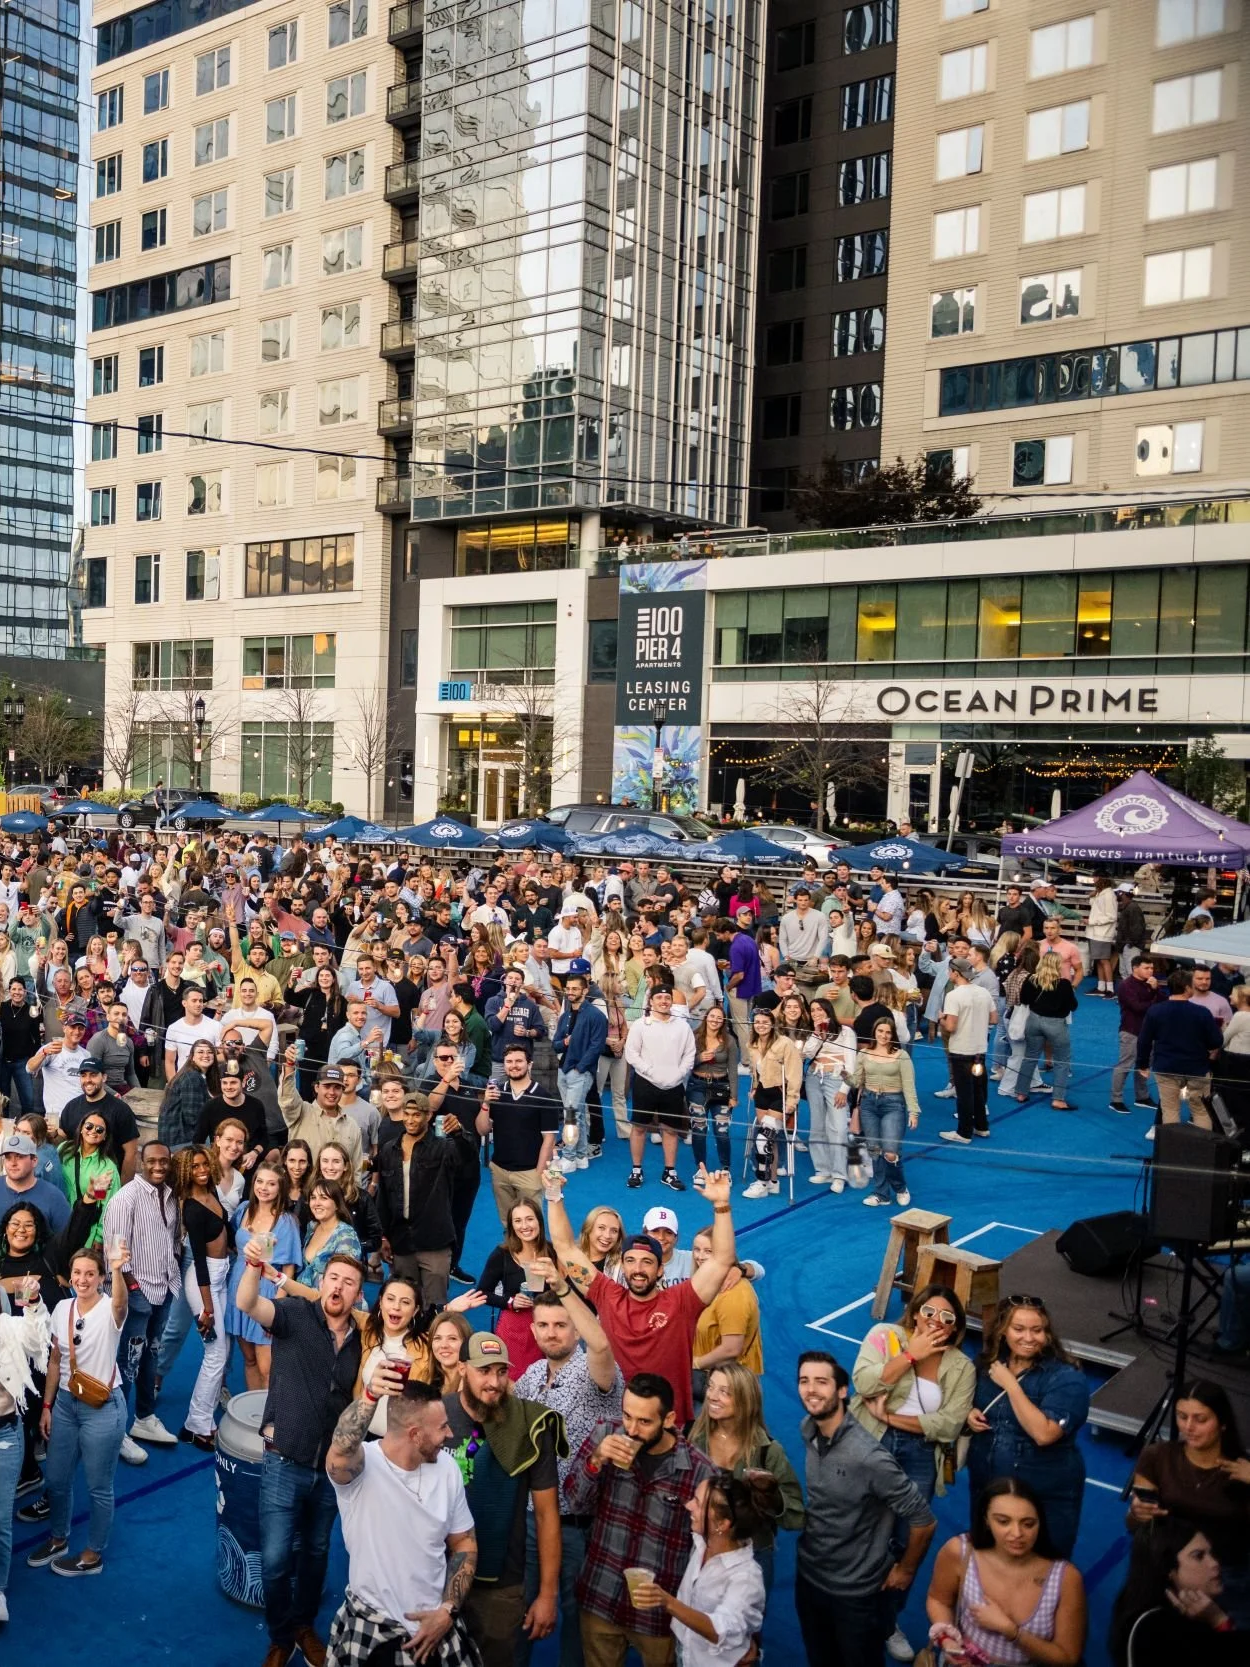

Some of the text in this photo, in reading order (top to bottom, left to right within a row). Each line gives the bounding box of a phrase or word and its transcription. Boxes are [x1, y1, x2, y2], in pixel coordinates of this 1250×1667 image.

[635, 636, 682, 661] PIER 4
[635, 661, 682, 669] APARTMENTS
[626, 680, 691, 694] LEASING
[876, 685, 1159, 716] OCEAN PRIME
[1015, 842, 1228, 864] cisco brewers nantucket
[659, 1211, 667, 1220] B
[215, 1450, 237, 1474] ONLY
